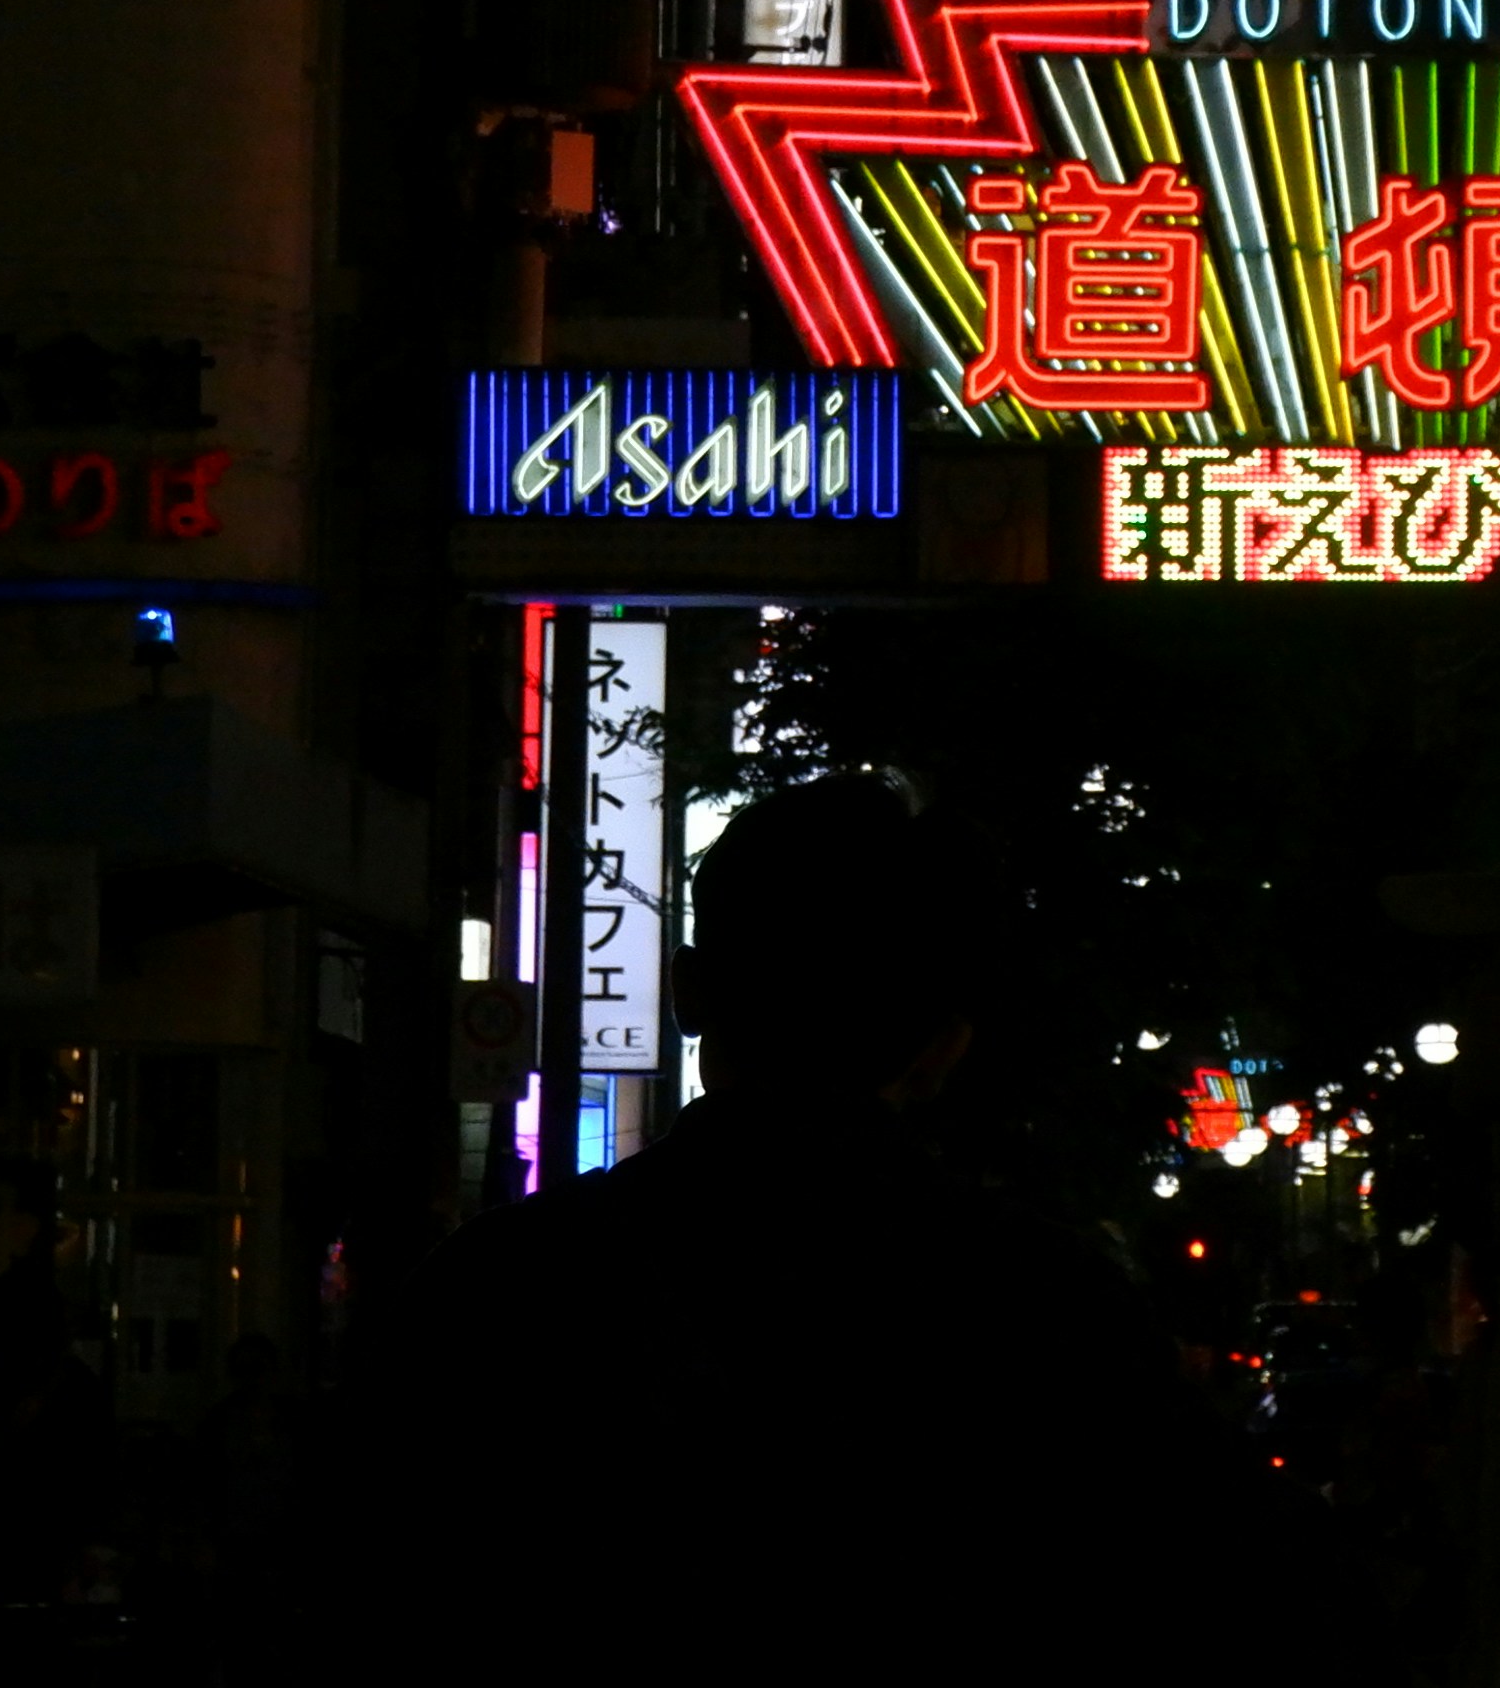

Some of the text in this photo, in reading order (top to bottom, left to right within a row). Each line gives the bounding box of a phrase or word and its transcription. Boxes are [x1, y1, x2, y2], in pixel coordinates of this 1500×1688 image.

[512, 379, 850, 506] Asahi
[583, 648, 631, 1001] ネットカフェ
